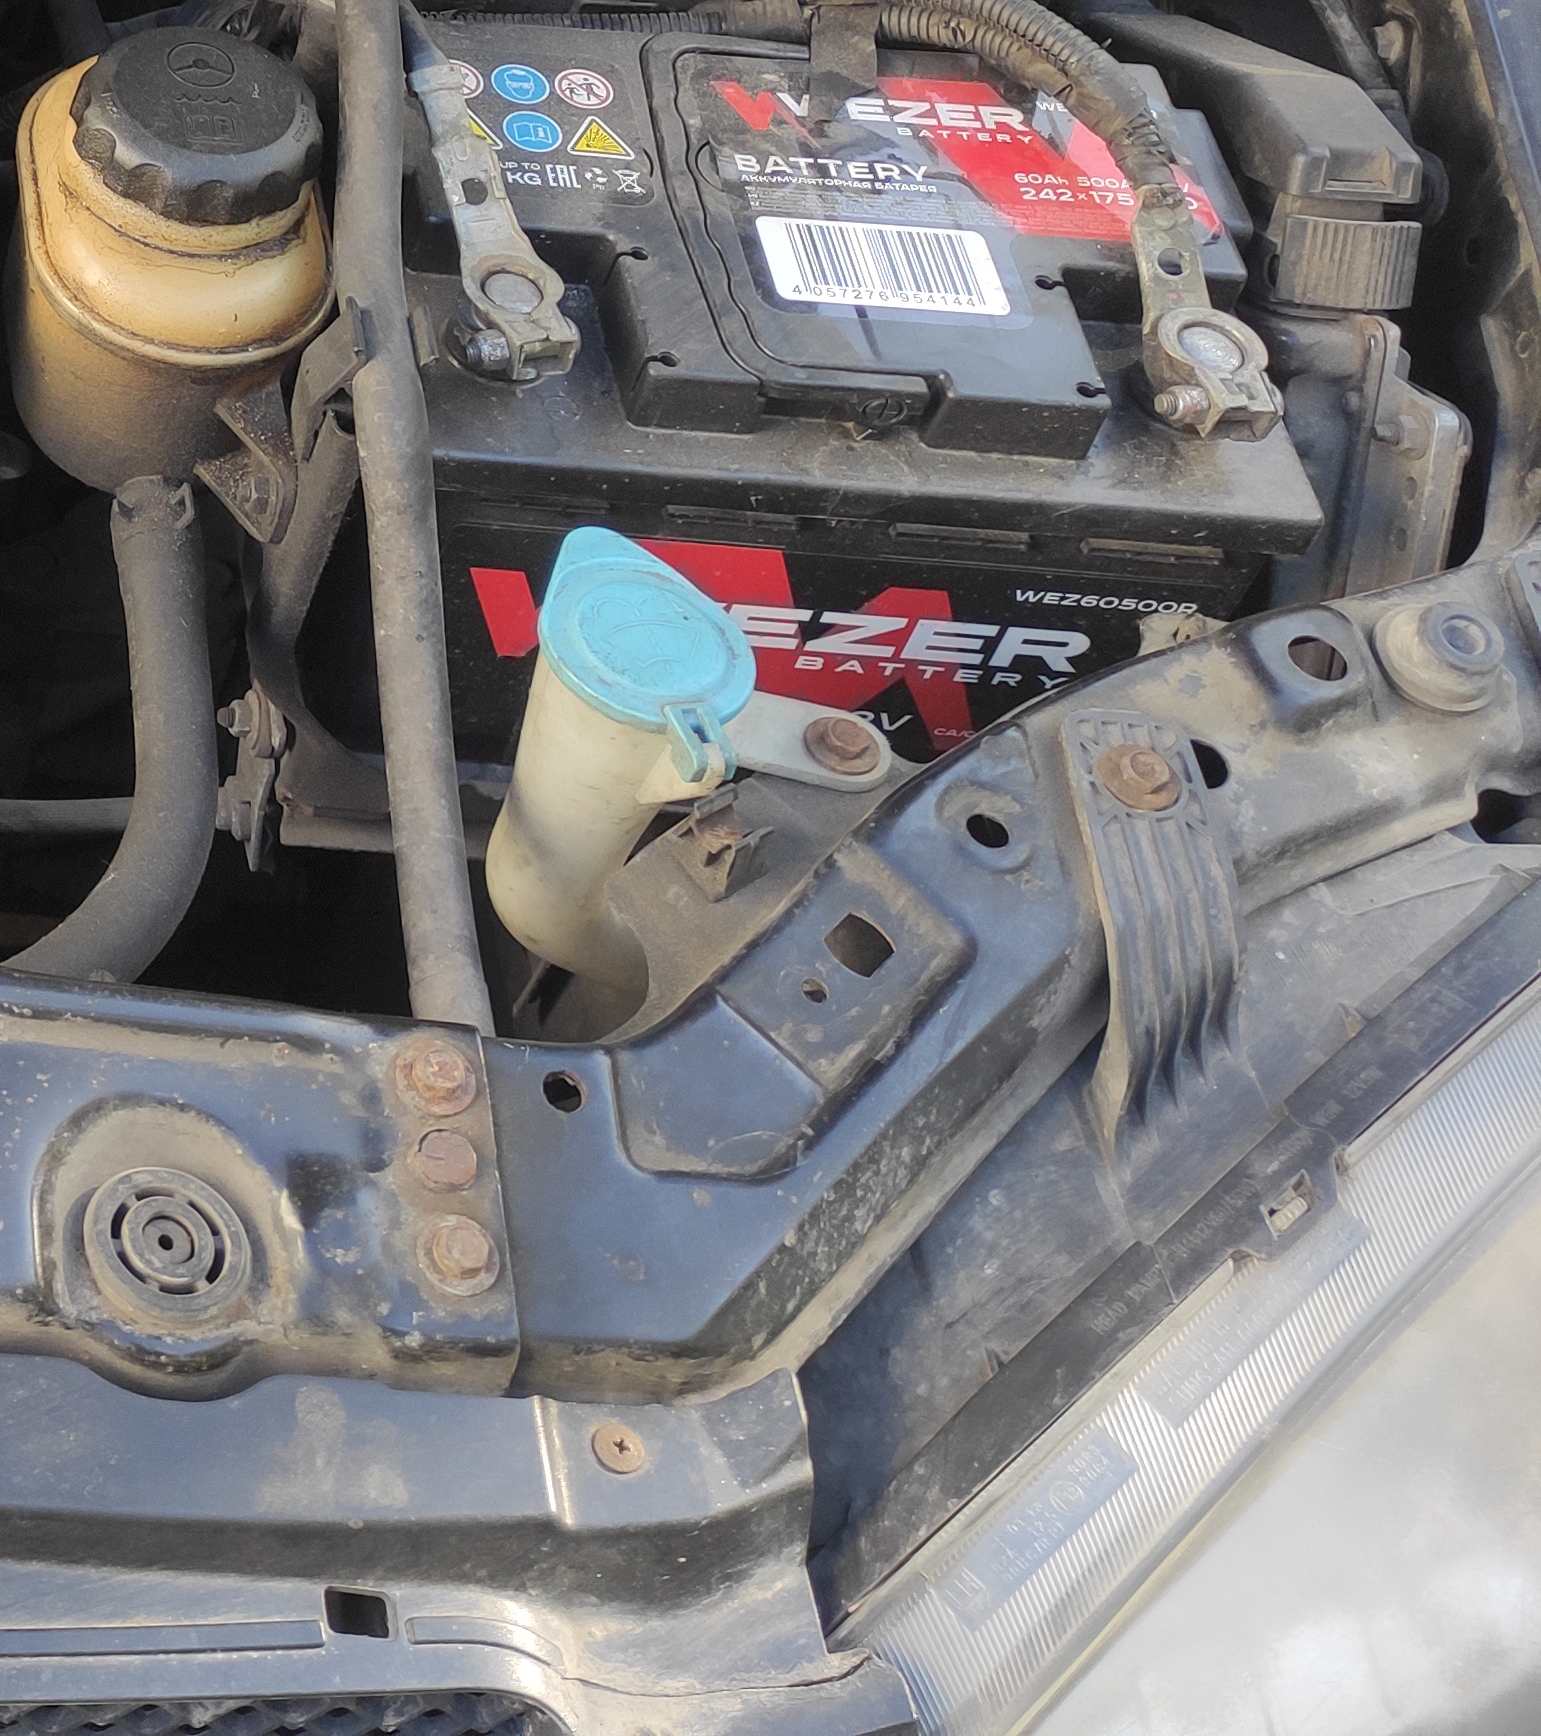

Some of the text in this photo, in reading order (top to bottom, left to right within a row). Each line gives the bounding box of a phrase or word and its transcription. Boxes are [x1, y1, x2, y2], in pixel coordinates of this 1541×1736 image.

[896, 127, 1034, 144] BATTERY
[521, 162, 541, 171] TO
[733, 154, 928, 182] BATTERY
[506, 171, 542, 186] KG
[740, 173, 938, 193] АККУМУЛЯТОРНАЯ БАТАРЕЯ
[1014, 173, 1069, 187] 60Ah
[792, 284, 977, 308] 4 057276 954144
[719, 602, 1091, 673] EZER
[794, 655, 1071, 690] BATTERY
